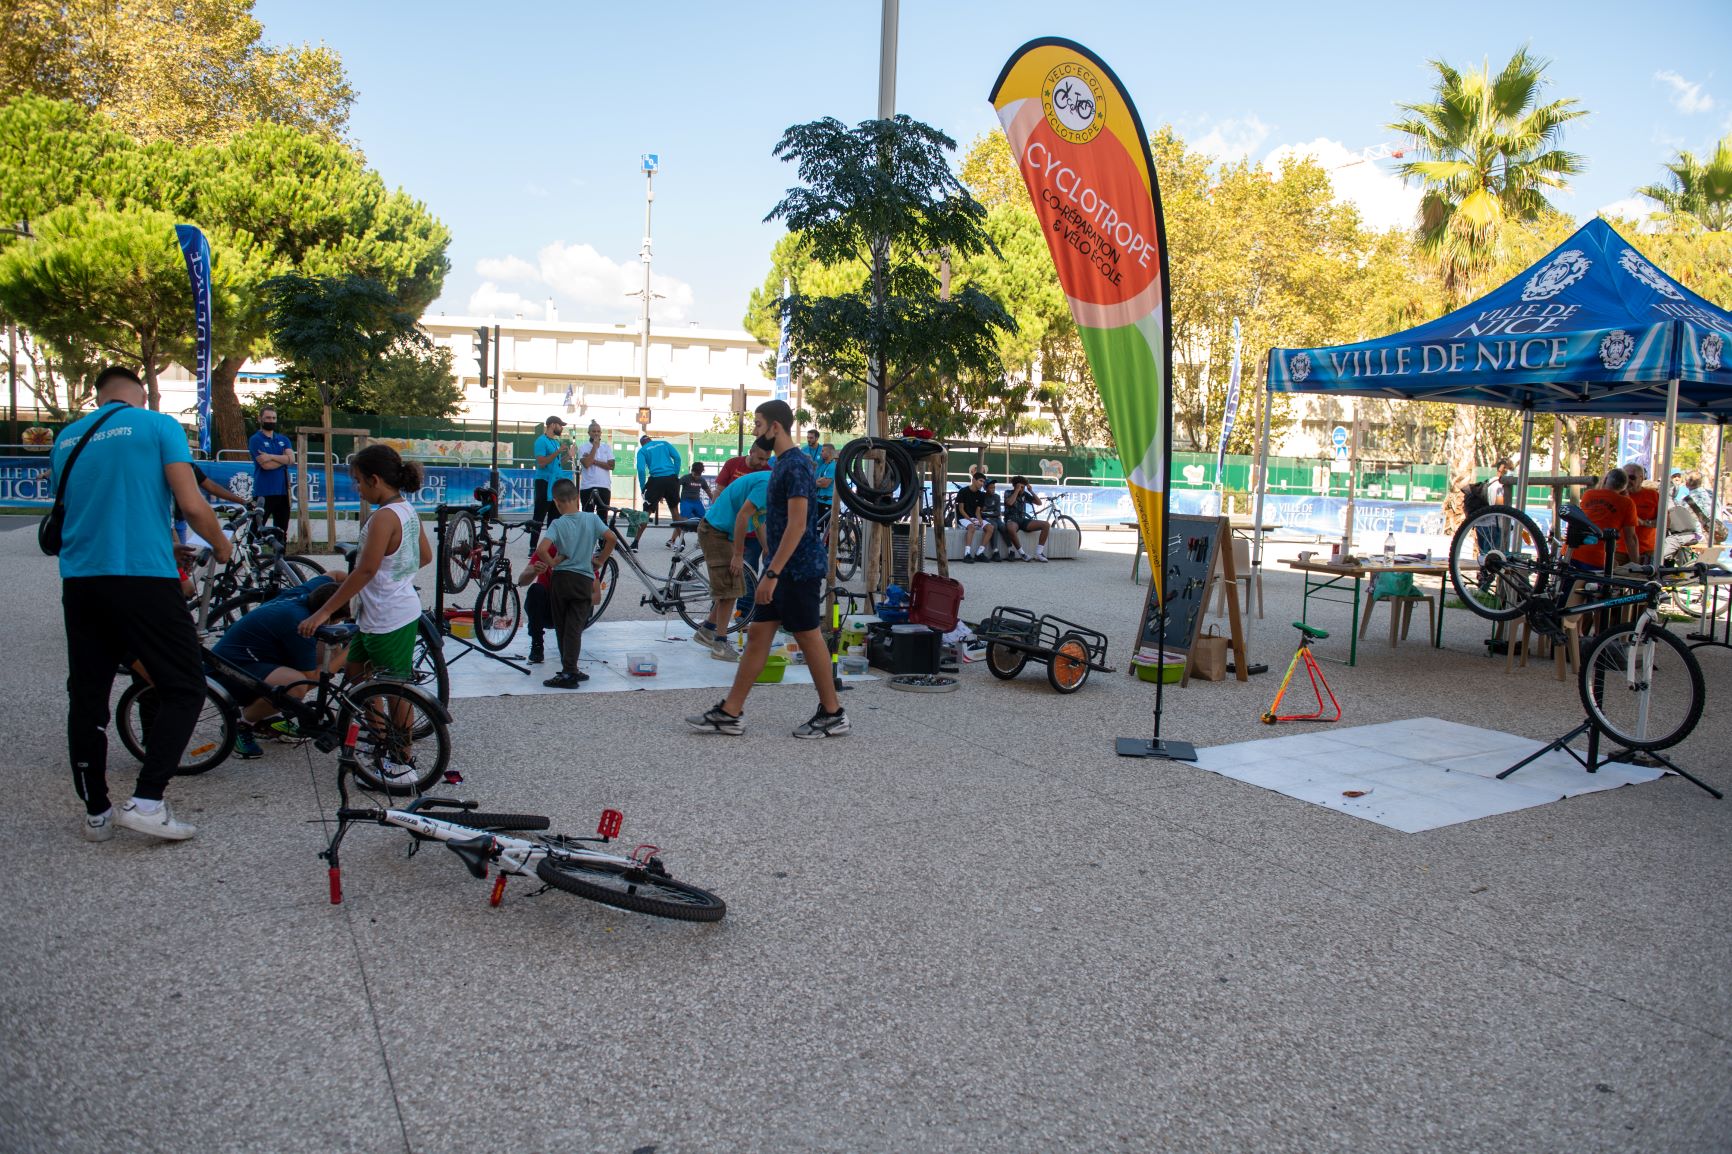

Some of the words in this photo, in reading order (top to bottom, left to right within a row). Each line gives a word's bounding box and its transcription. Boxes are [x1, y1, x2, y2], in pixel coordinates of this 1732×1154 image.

[1044, 102, 1100, 142] CYCLOTROPE
[1027, 142, 1155, 268] CYCLOTROPE
[1042, 189, 1121, 264] CO-RÉPARATION
[1064, 226, 1091, 255] VÉLO
[1091, 250, 1123, 287] ÉCOLE
[1477, 304, 1541, 322] VILLE
[1540, 304, 1582, 317] DE
[1453, 316, 1568, 338] NICE
[1330, 350, 1411, 378] VILLE
[1419, 343, 1466, 375] DE
[1472, 337, 1568, 372] NICE
[107, 427, 132, 439] SPORTS
[0, 479, 49, 499] ICE
[429, 475, 447, 487] DE
[1279, 503, 1301, 513] VILLE
[1302, 503, 1313, 513] DE
[1355, 506, 1380, 518] VILLE
[1381, 507, 1395, 518] DE
[1278, 512, 1313, 528] NICE
[1354, 517, 1395, 533] NICE
